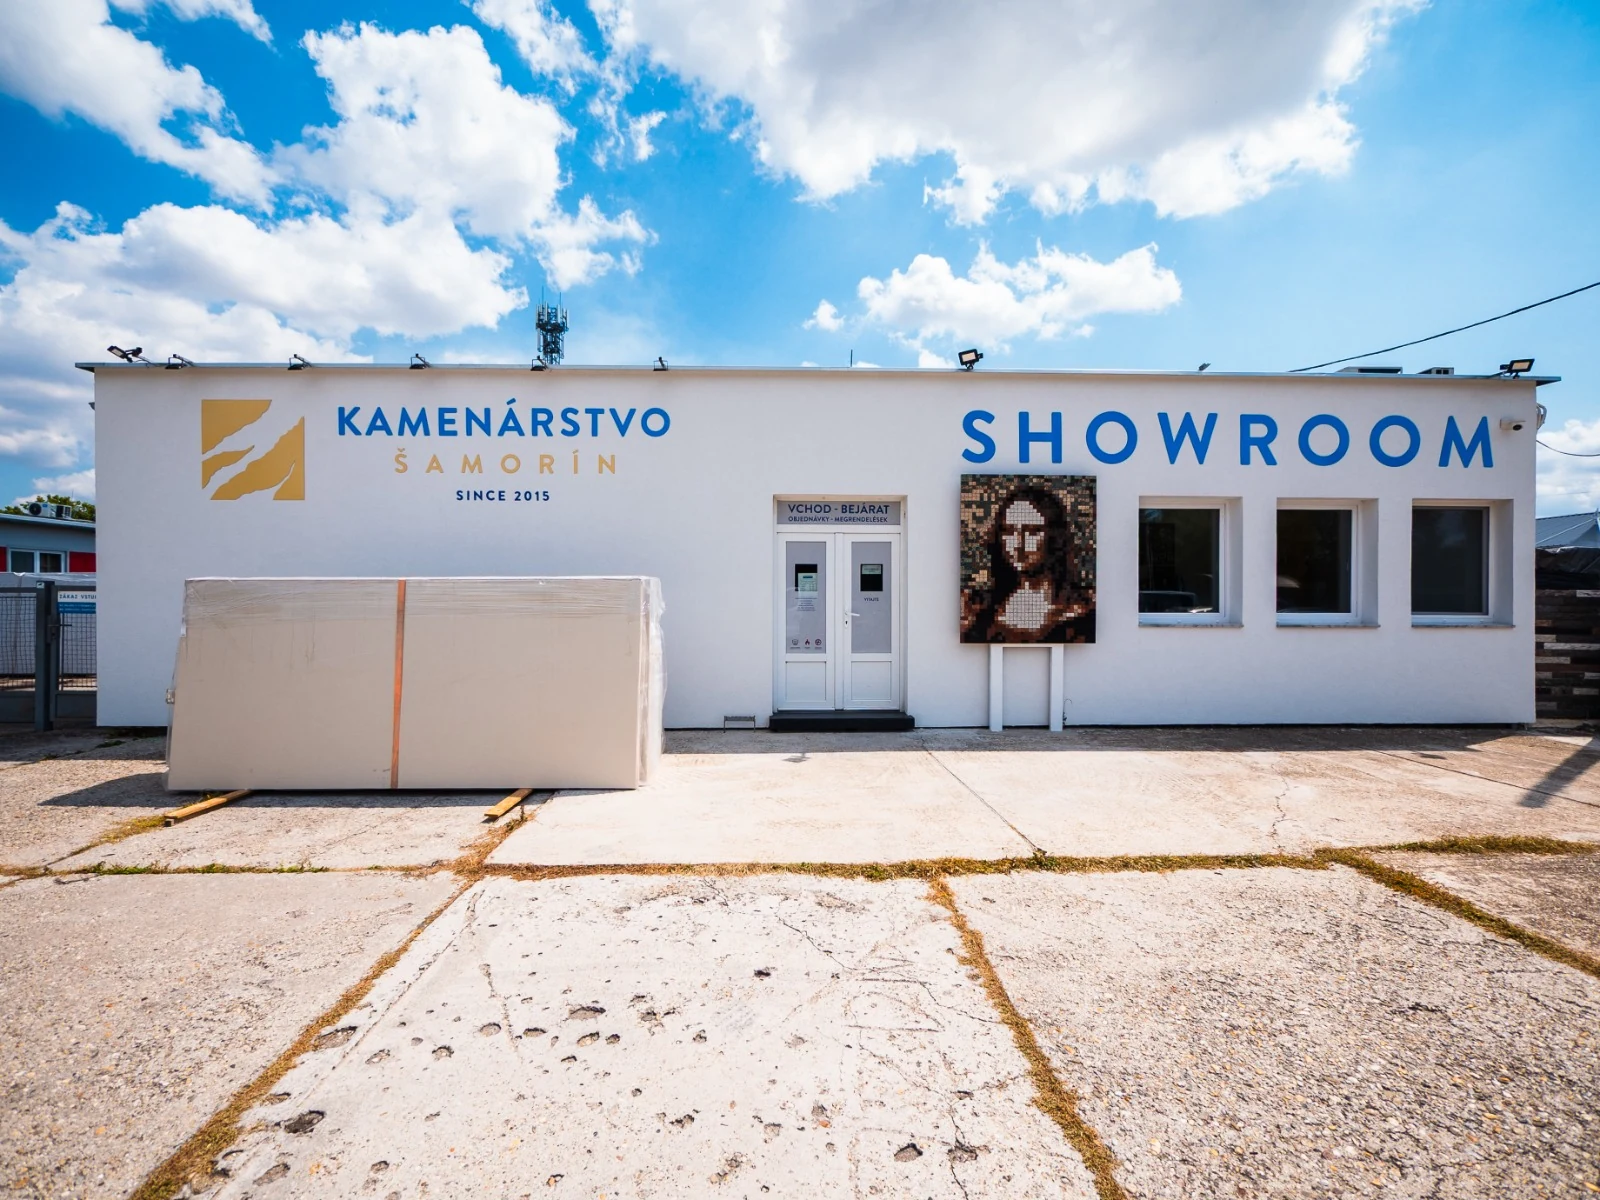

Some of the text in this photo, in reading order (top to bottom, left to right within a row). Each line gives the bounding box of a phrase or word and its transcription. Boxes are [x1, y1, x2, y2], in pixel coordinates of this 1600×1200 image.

[338, 398, 671, 437] KAMENÁRSTVO
[961, 410, 1494, 468] SHOWROOM
[394, 448, 616, 475] ŠAMORÍN
[456, 490, 550, 502] SINCE 2015
[788, 504, 831, 514] VCHOD
[841, 502, 890, 514] BEJÁRAT
